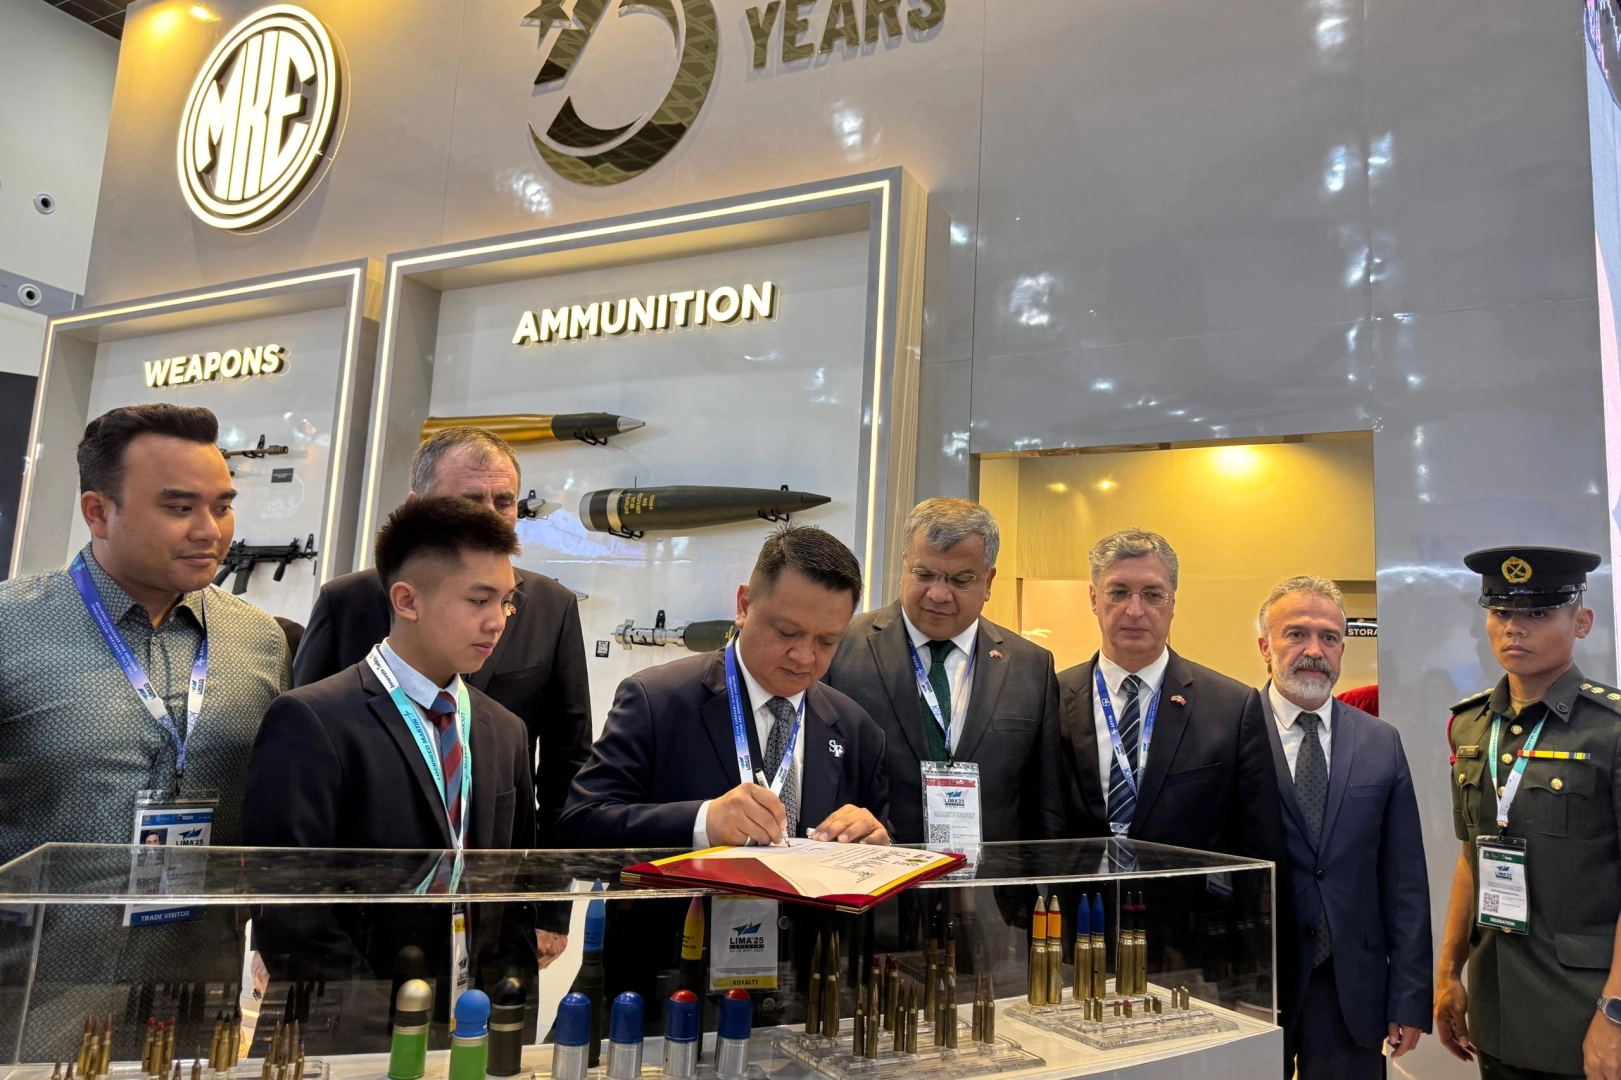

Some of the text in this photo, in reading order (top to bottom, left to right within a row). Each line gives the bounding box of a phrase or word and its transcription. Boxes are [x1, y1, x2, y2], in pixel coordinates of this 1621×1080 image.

[745, 0, 946, 69] YEARS
[194, 30, 316, 201] MKE
[511, 281, 773, 345] AMMUNITION
[144, 343, 284, 388] WEAPONS
[411, 718, 427, 744] MARTIN
[141, 911, 190, 922] TRADE VISITOR
